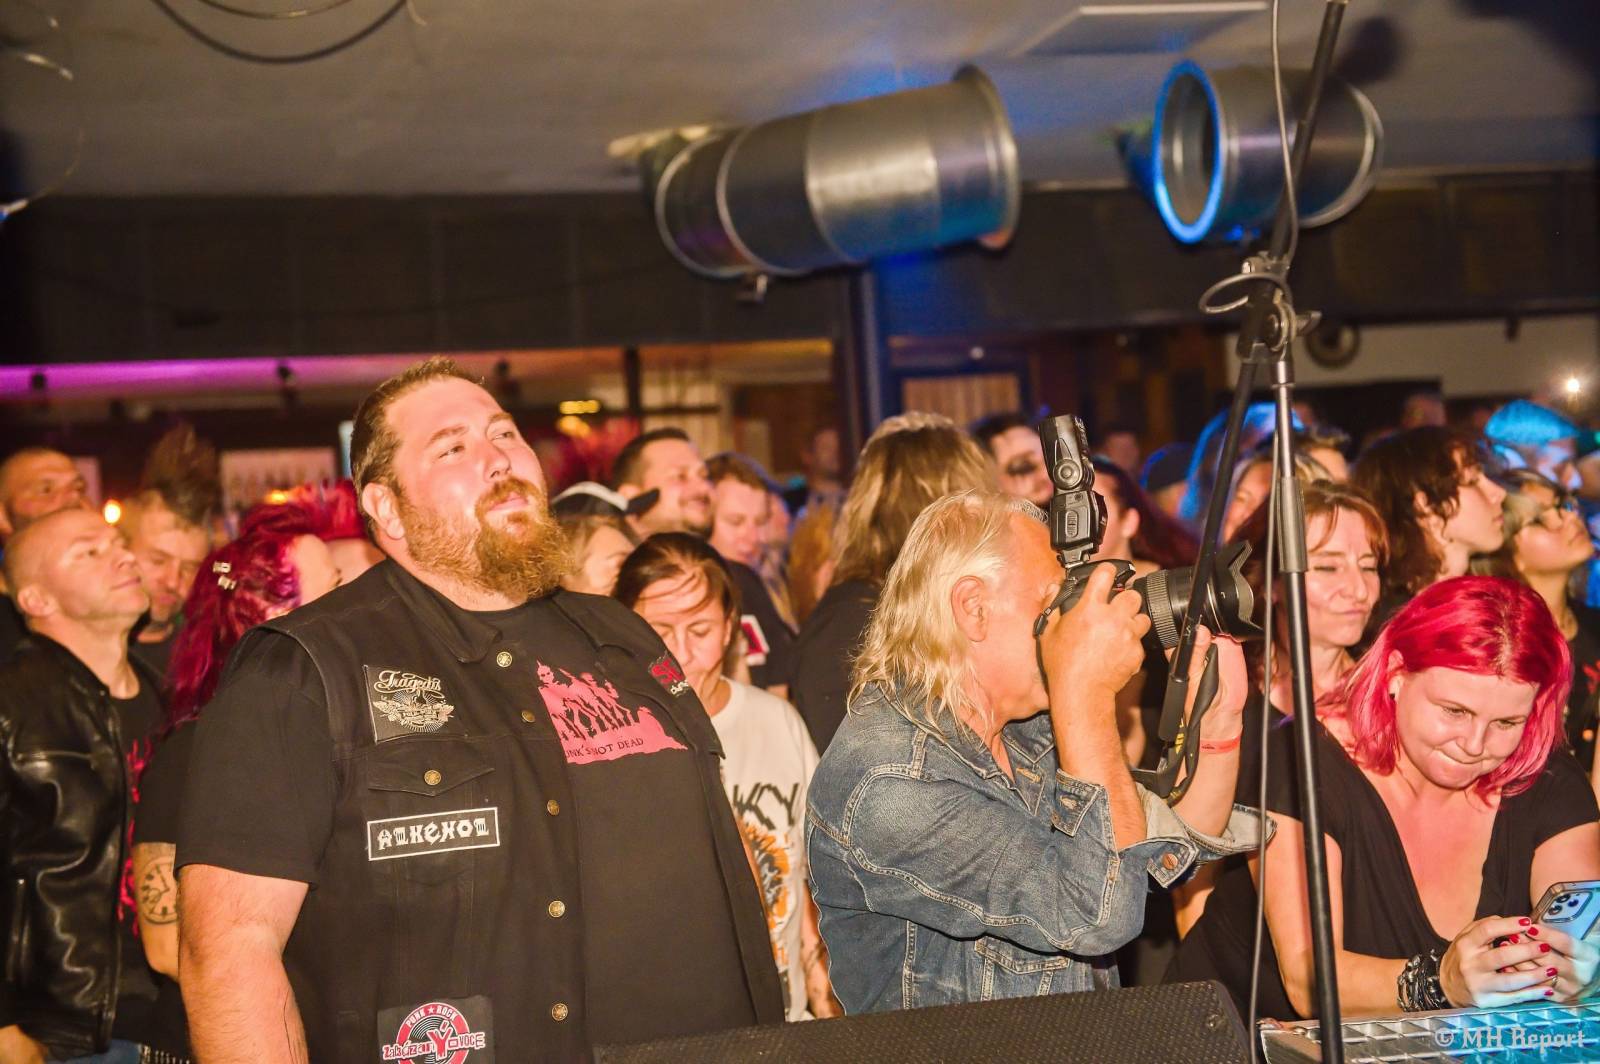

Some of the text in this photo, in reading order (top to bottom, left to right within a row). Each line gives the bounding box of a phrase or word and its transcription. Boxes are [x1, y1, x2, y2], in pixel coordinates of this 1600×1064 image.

[617, 737, 644, 750] DEAD
[405, 1005, 459, 1029] PUNK ROCK
